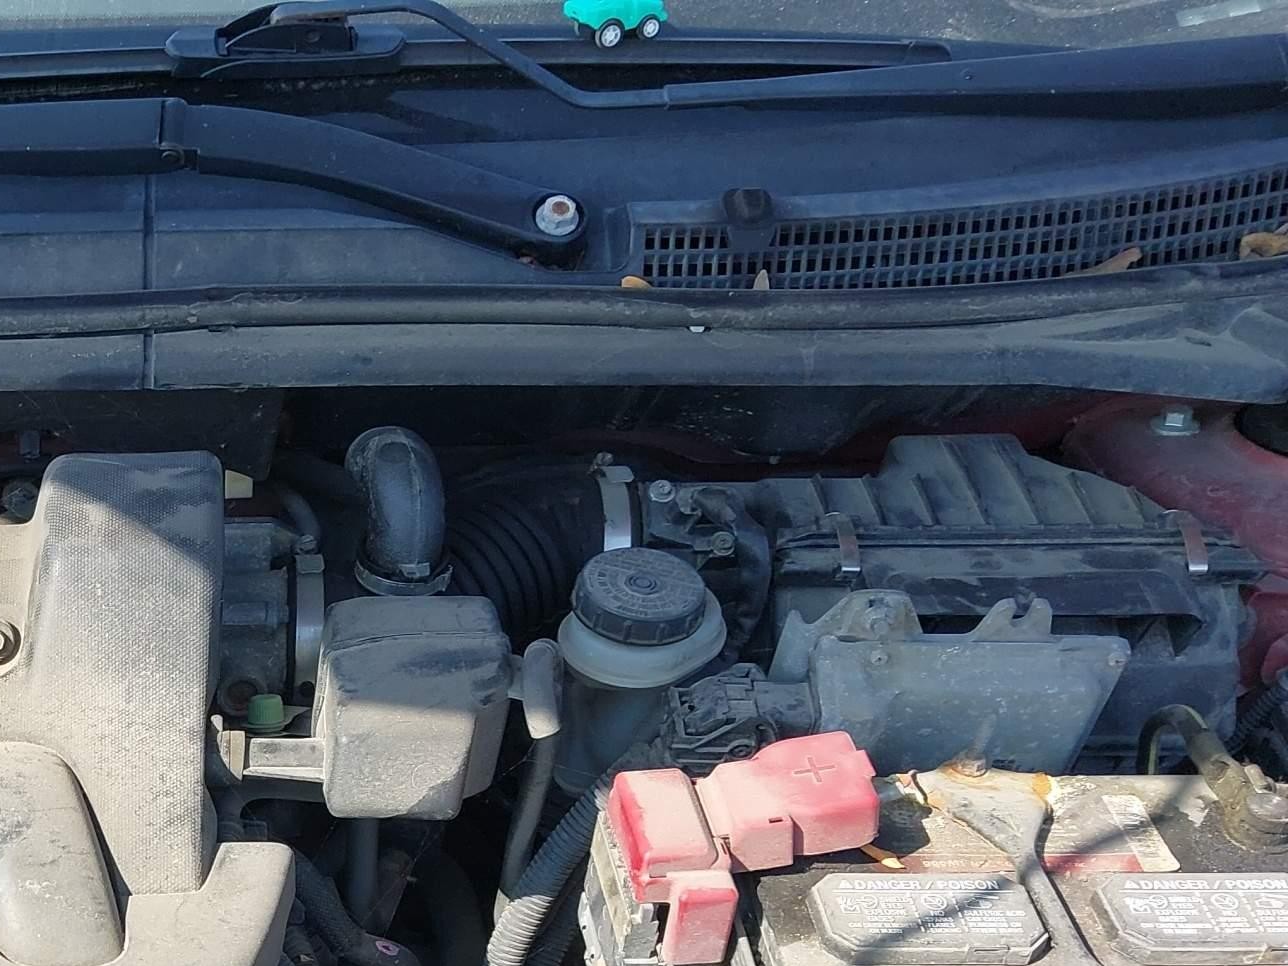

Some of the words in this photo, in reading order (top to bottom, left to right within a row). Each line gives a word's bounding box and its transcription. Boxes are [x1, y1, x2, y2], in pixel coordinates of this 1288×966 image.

[853, 880, 920, 889] DANGER
[937, 880, 999, 889] POISON
[1139, 880, 1209, 889] DANGER
[1224, 880, 1288, 889] POISON
